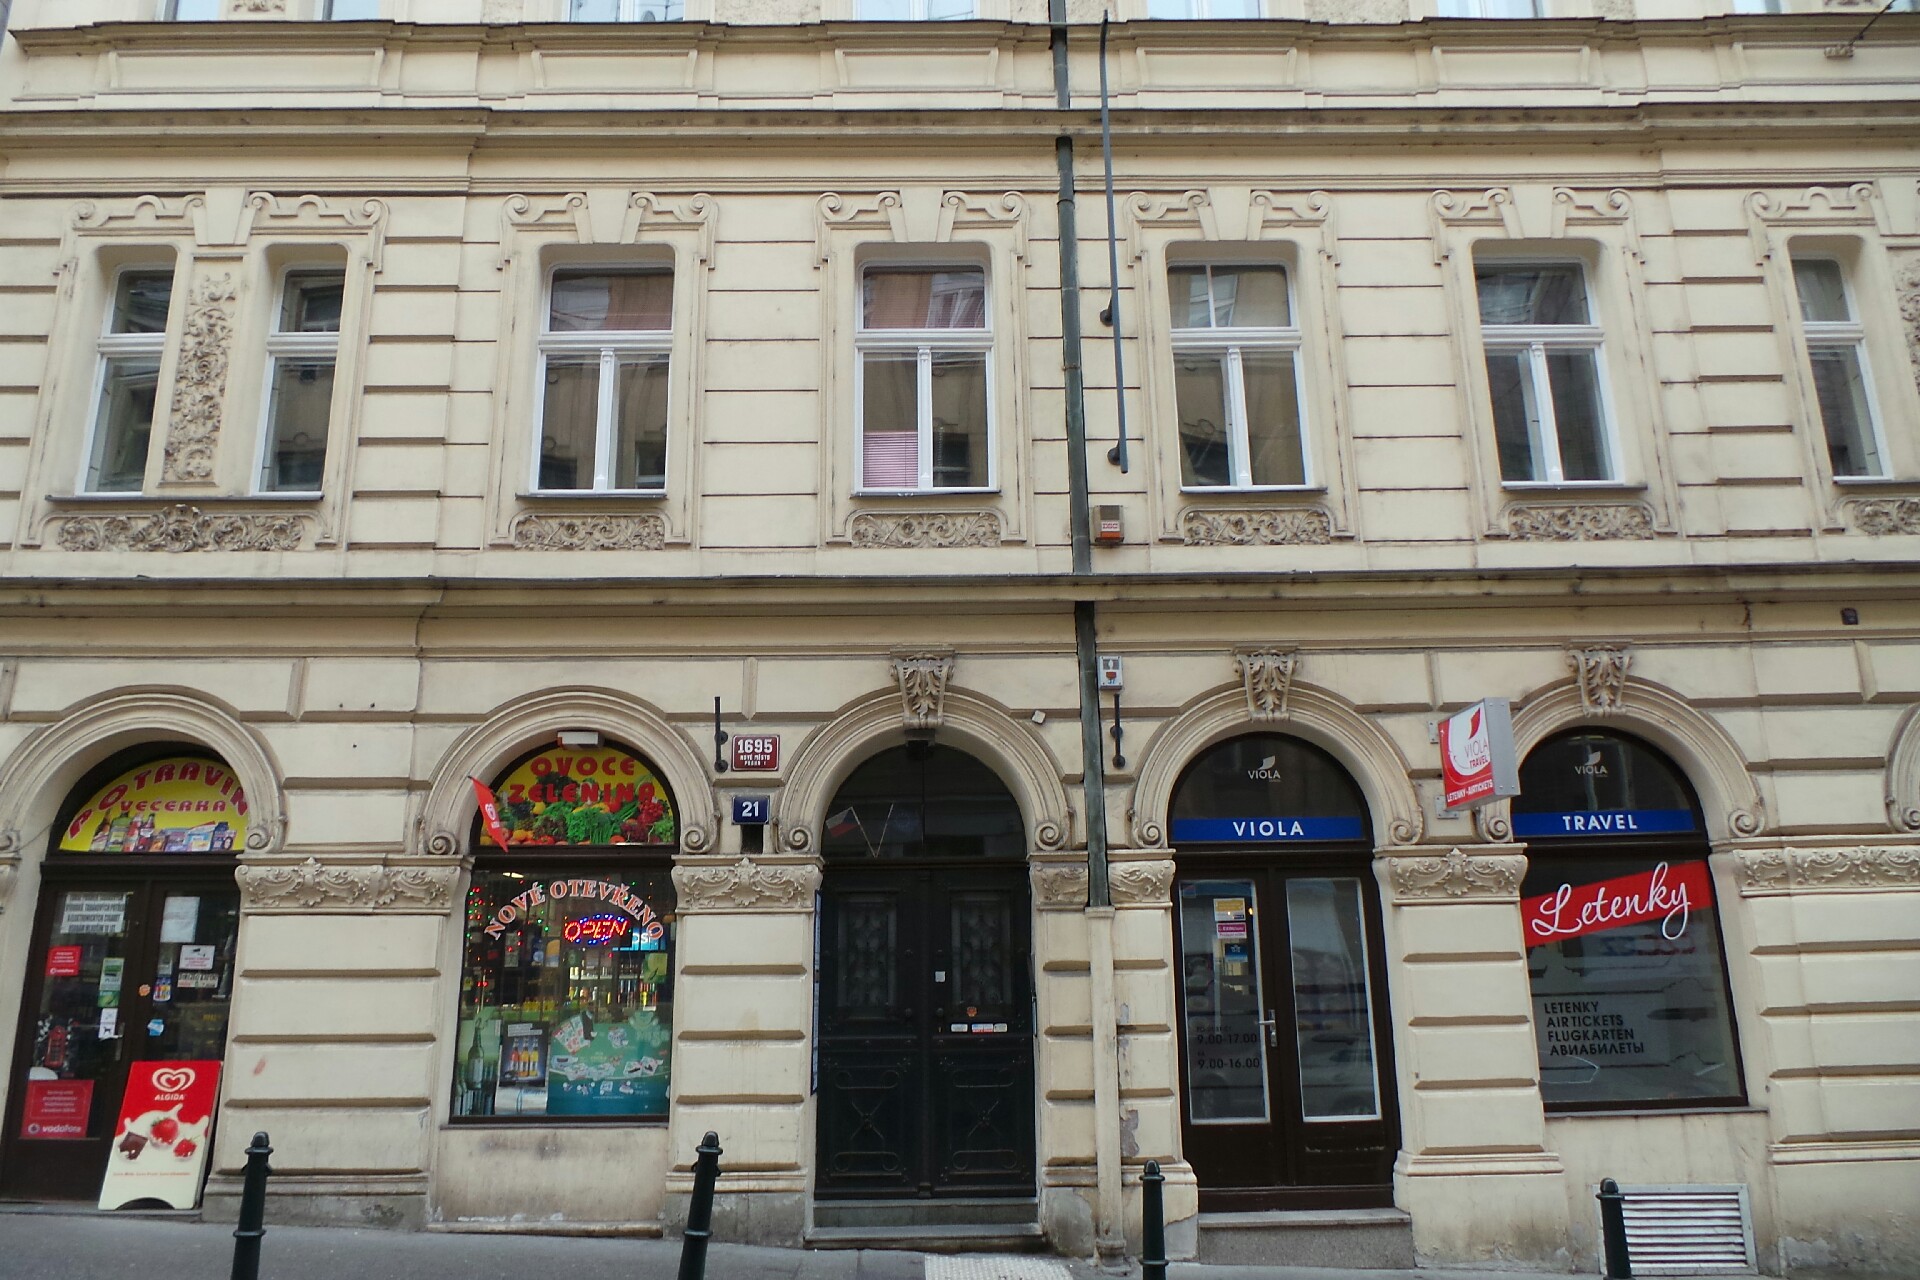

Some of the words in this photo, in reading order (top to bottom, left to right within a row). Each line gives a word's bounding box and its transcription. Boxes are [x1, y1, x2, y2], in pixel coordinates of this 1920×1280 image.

[737, 739, 773, 753] 1695
[1464, 737, 1489, 758] VIOLA
[530, 757, 635, 776] OVOCE
[1469, 754, 1489, 769] TRAVEL
[1247, 769, 1281, 779] VIOLA
[1574, 765, 1608, 775] VIOLA
[507, 782, 656, 803] ZELENINA
[120, 797, 226, 812] VEČERKA
[741, 801, 759, 817] 21
[1233, 820, 1304, 837] VIOLA
[1562, 813, 1638, 831] TRAVEL
[1531, 861, 1692, 940] Letenky
[484, 882, 546, 941] NOVÉ
[549, 879, 664, 940] OTEVŘENO
[564, 920, 628, 942] OPEN
[1544, 1001, 1599, 1014] LETENKY
[1197, 1033, 1257, 1045] 9.00-17.00
[1548, 1028, 1635, 1042] FLUGKARTEN
[1550, 1041, 1645, 1056] АВИАБИЛЕТЫ
[1198, 1057, 1260, 1069] 9.00-16.00
[154, 1093, 185, 1101] ALGIDA
